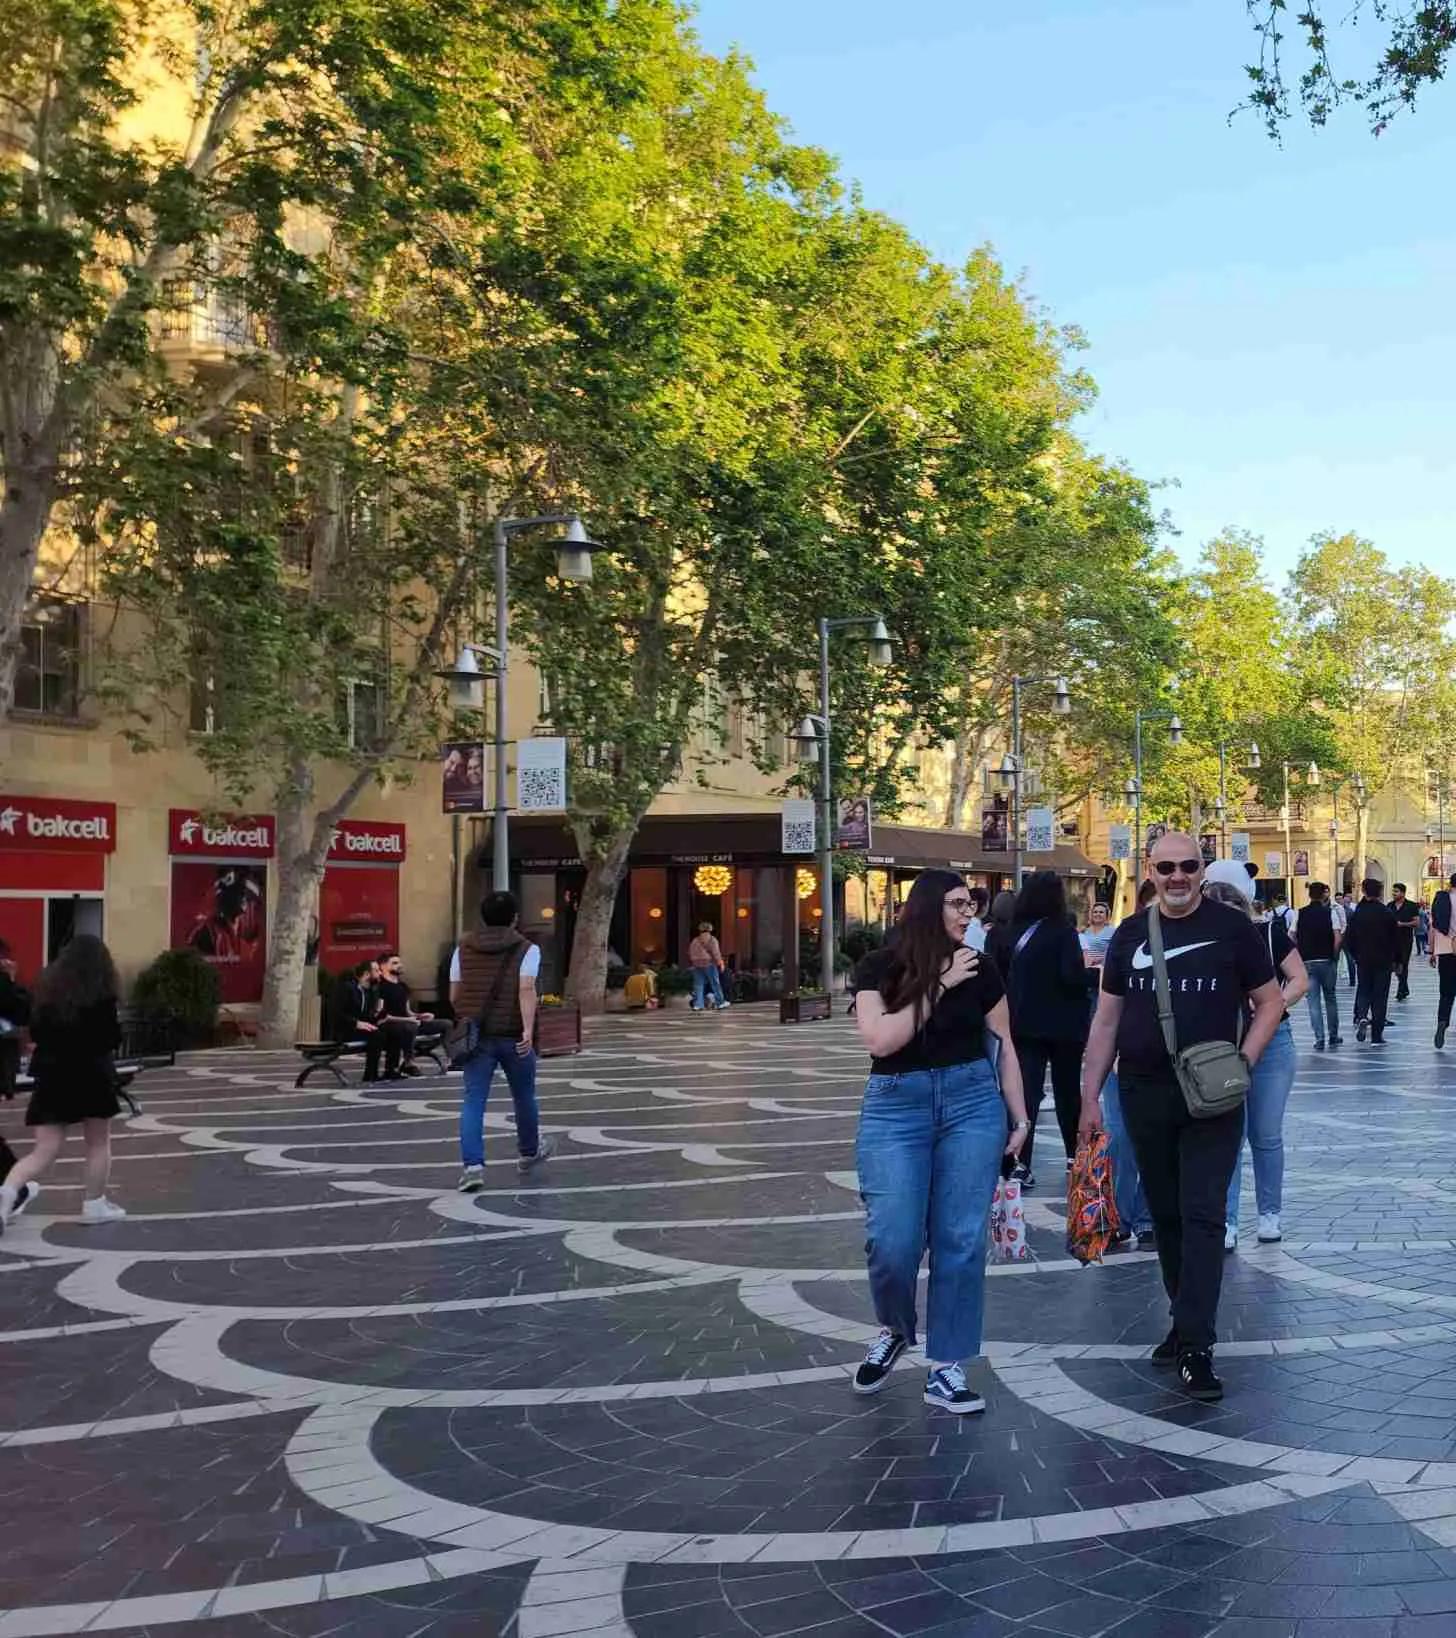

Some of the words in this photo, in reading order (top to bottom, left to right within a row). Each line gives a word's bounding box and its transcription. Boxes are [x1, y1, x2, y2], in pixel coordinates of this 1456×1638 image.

[27, 812, 110, 839] bakcell
[202, 819, 270, 847] bakcell
[344, 831, 402, 853] bakcell
